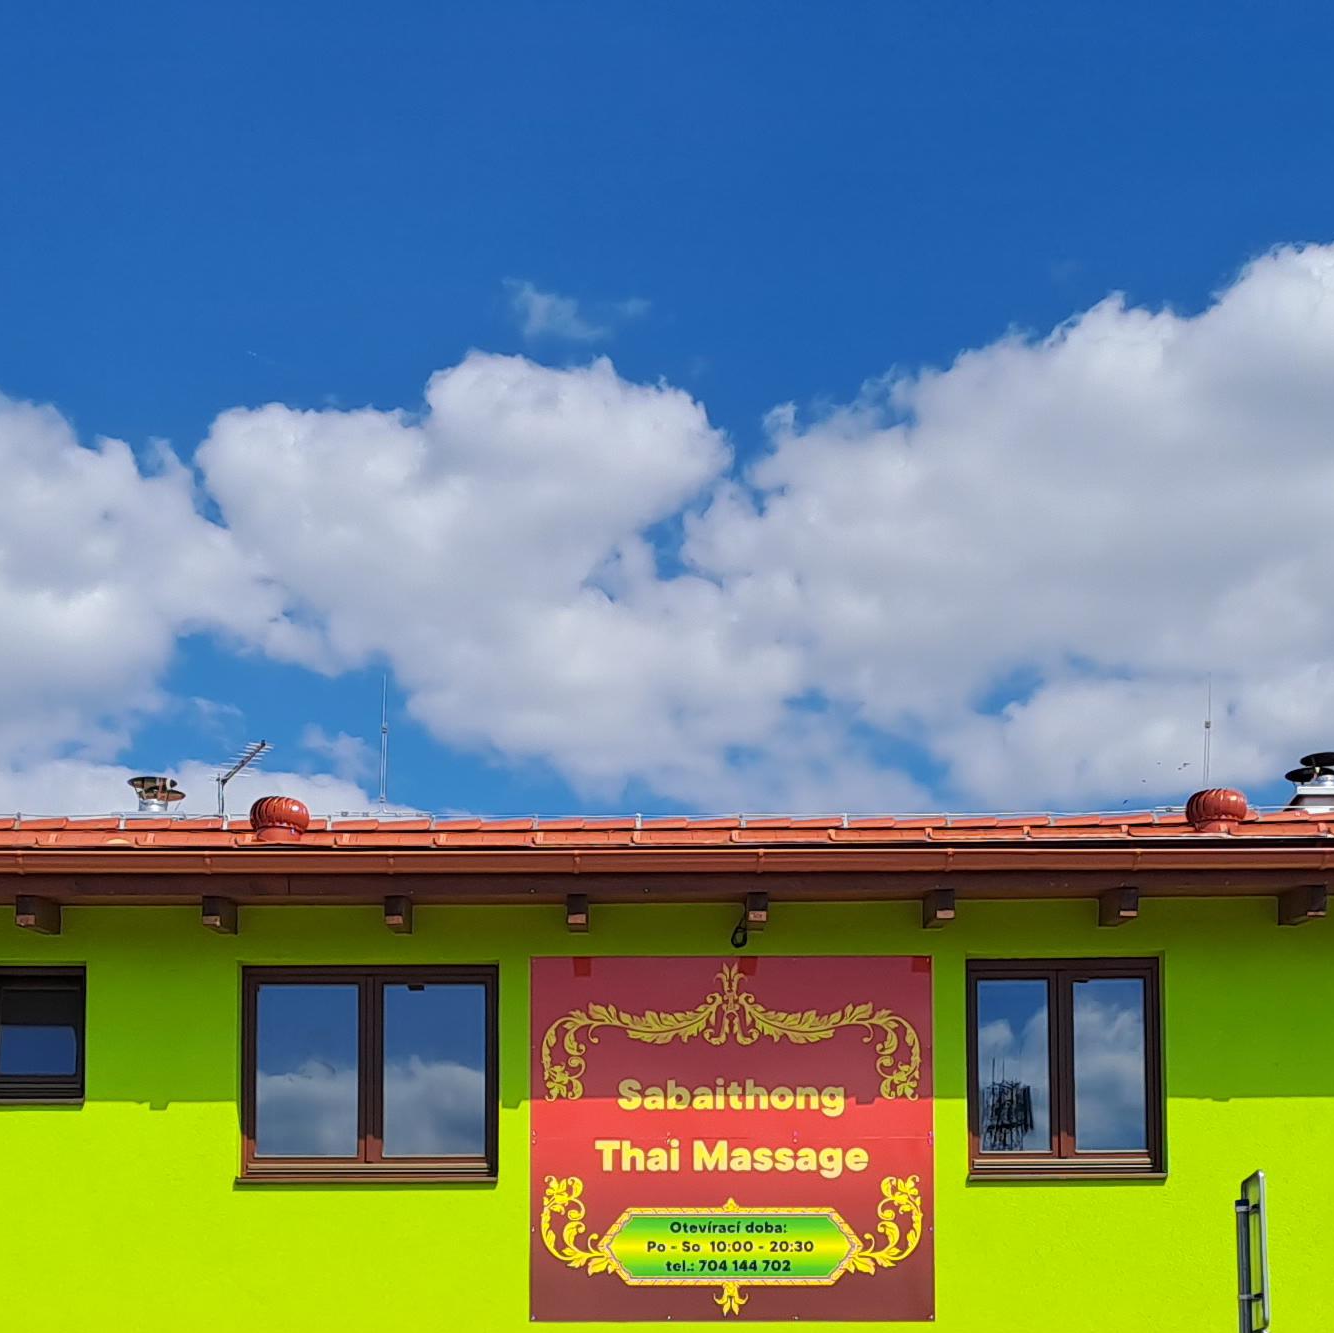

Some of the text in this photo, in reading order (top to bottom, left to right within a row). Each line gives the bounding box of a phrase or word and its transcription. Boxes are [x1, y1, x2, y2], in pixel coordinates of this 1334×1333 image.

[617, 1077, 846, 1118] Sabaithong
[594, 1138, 870, 1179] Thai Massage
[669, 1221, 787, 1234] Otevírací doba:
[647, 1241, 666, 1253] Po
[682, 1241, 701, 1253] So
[709, 1241, 754, 1253] 10:00
[769, 1241, 814, 1253] 20:30
[665, 1260, 791, 1272] tel.: 704 144 702
